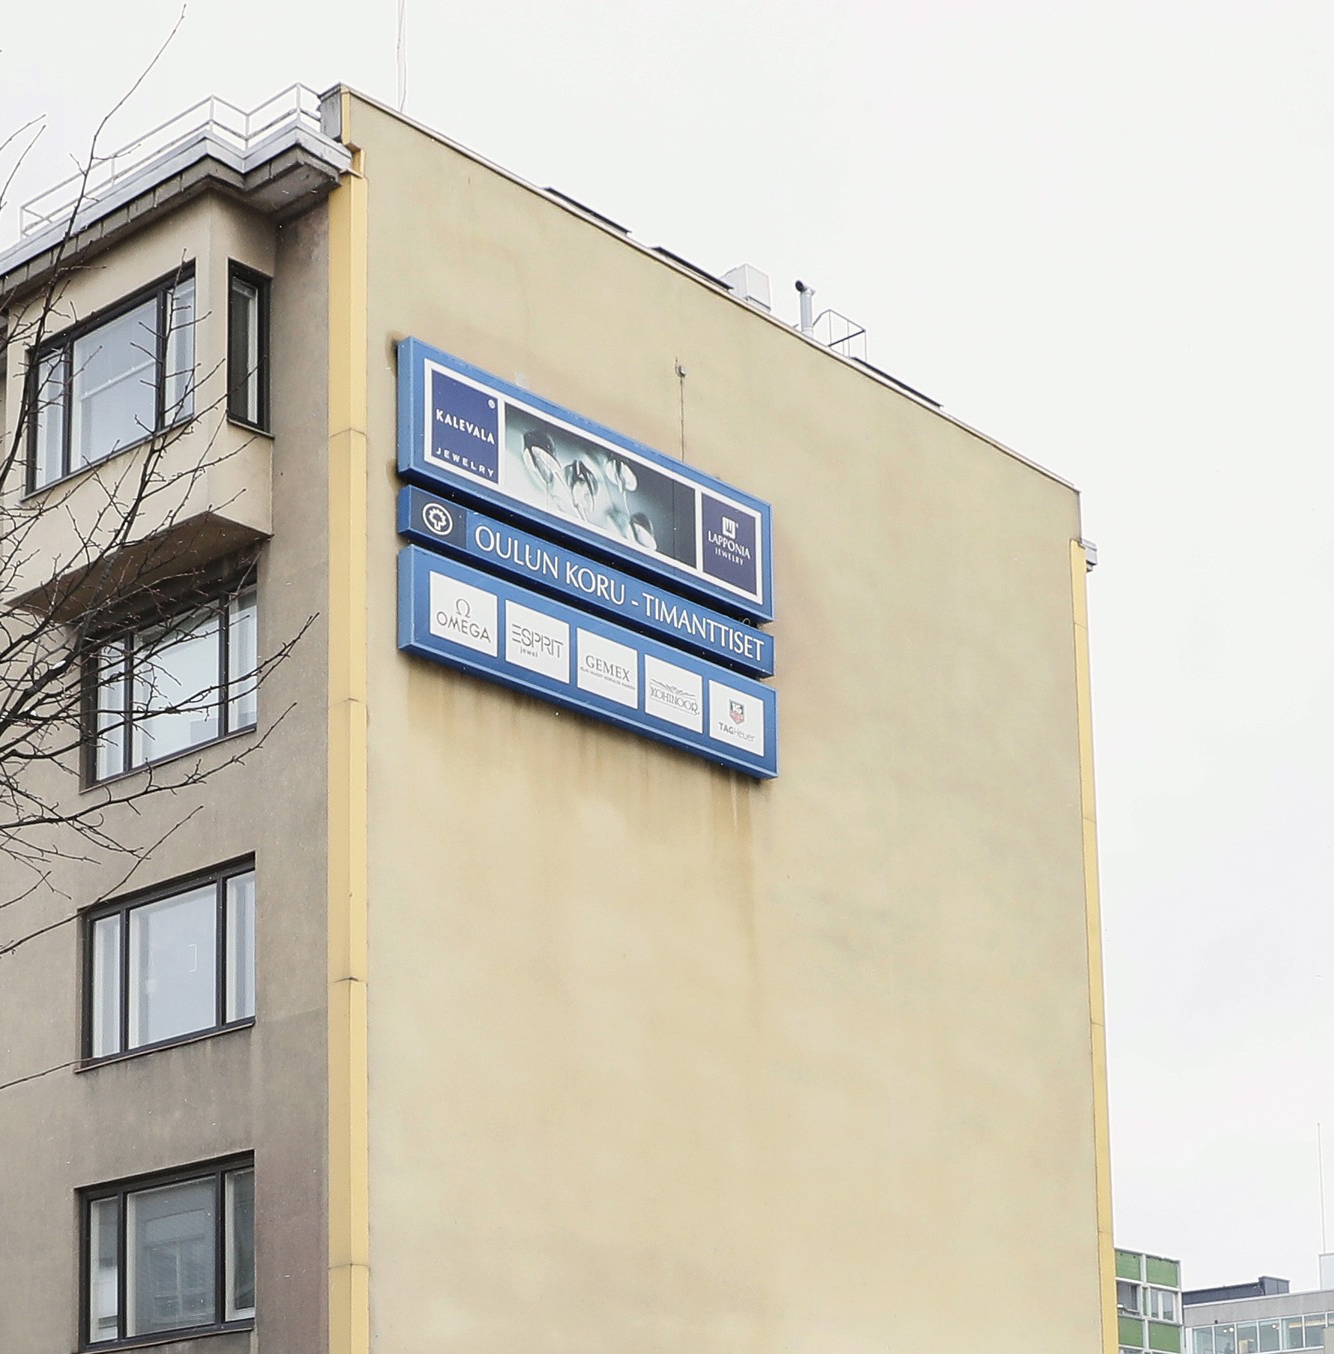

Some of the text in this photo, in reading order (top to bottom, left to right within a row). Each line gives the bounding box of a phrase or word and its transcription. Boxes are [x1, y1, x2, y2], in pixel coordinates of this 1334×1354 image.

[436, 409, 495, 445] KALEVALA
[436, 447, 494, 477] JEWELRY
[708, 530, 751, 560] LAPPONIA
[475, 525, 560, 579] OULUN
[566, 561, 626, 606] KORU
[642, 592, 765, 662] TIMANTTISET
[436, 611, 492, 644] OMEGA
[512, 623, 564, 659] ESPRIT
[585, 655, 631, 683] GEMEX
